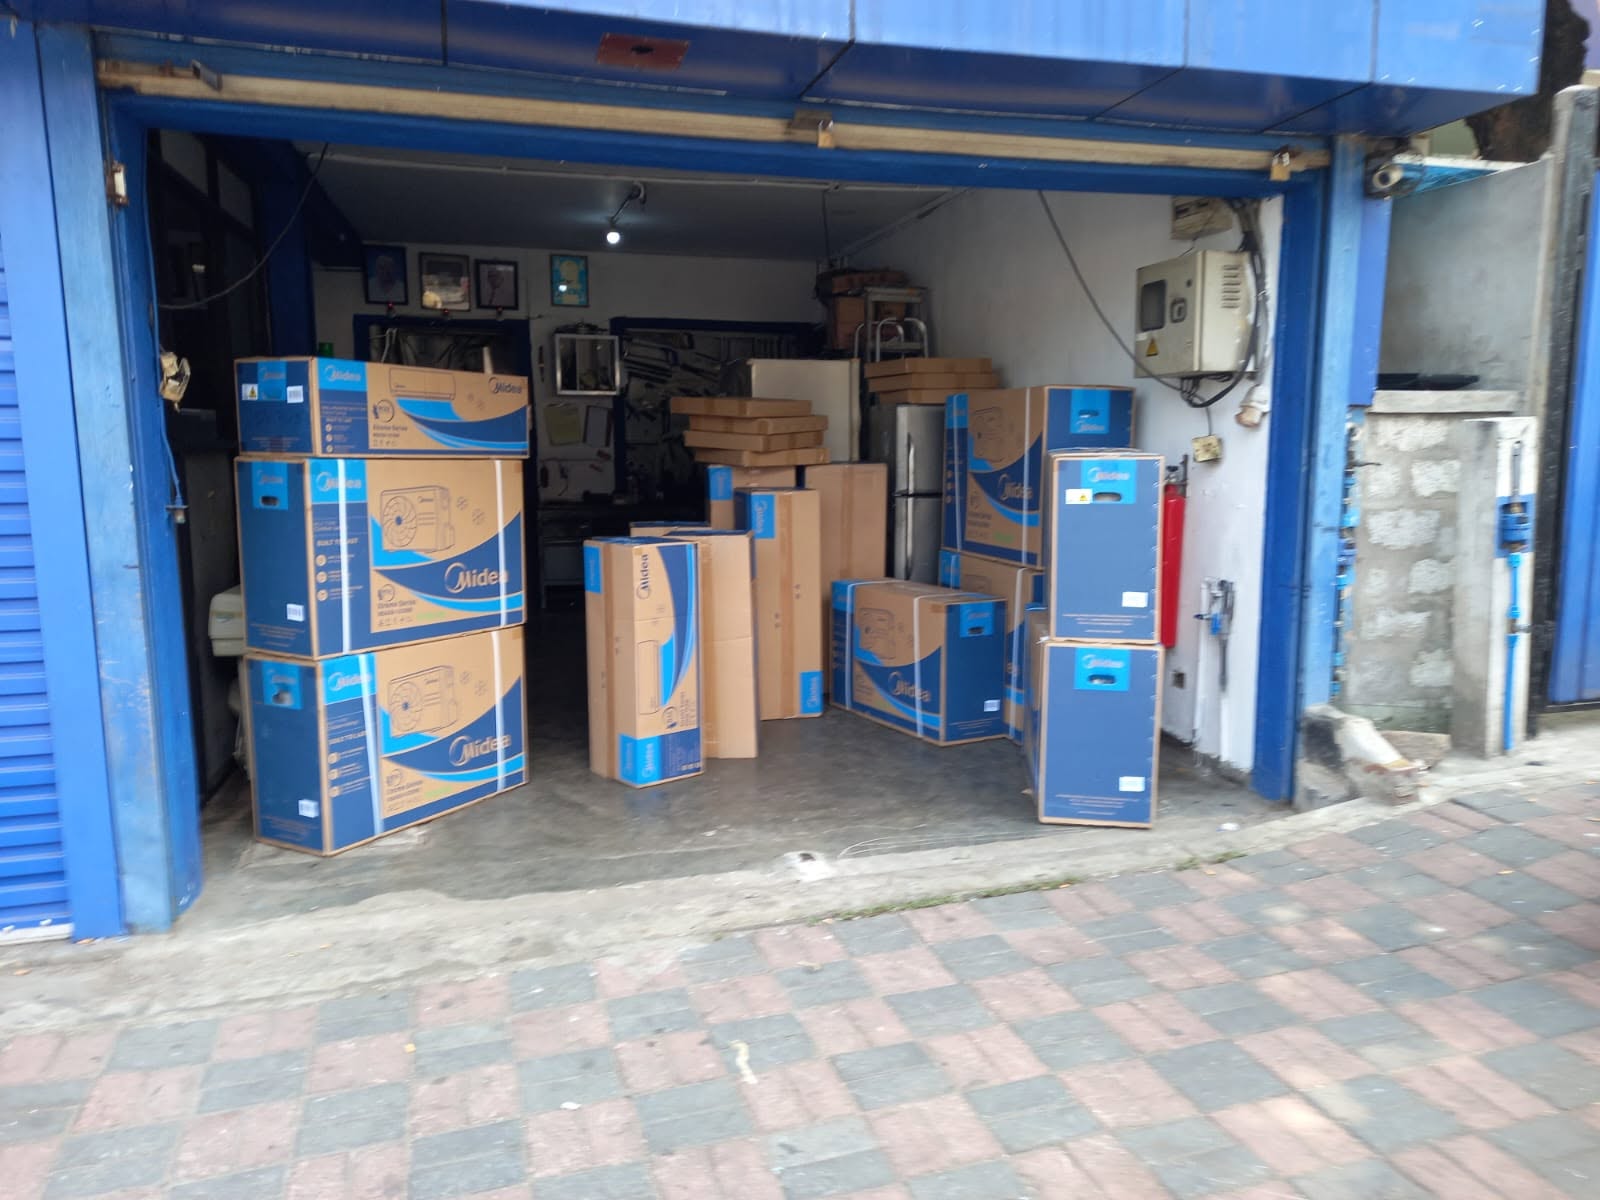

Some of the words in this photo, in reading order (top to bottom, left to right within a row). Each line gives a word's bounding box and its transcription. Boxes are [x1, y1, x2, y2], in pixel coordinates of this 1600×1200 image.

[324, 365, 361, 381] Midea
[488, 376, 522, 394] Midea
[1088, 466, 1131, 483] Midea
[636, 553, 651, 600] Midea
[448, 735, 512, 767] Midea
